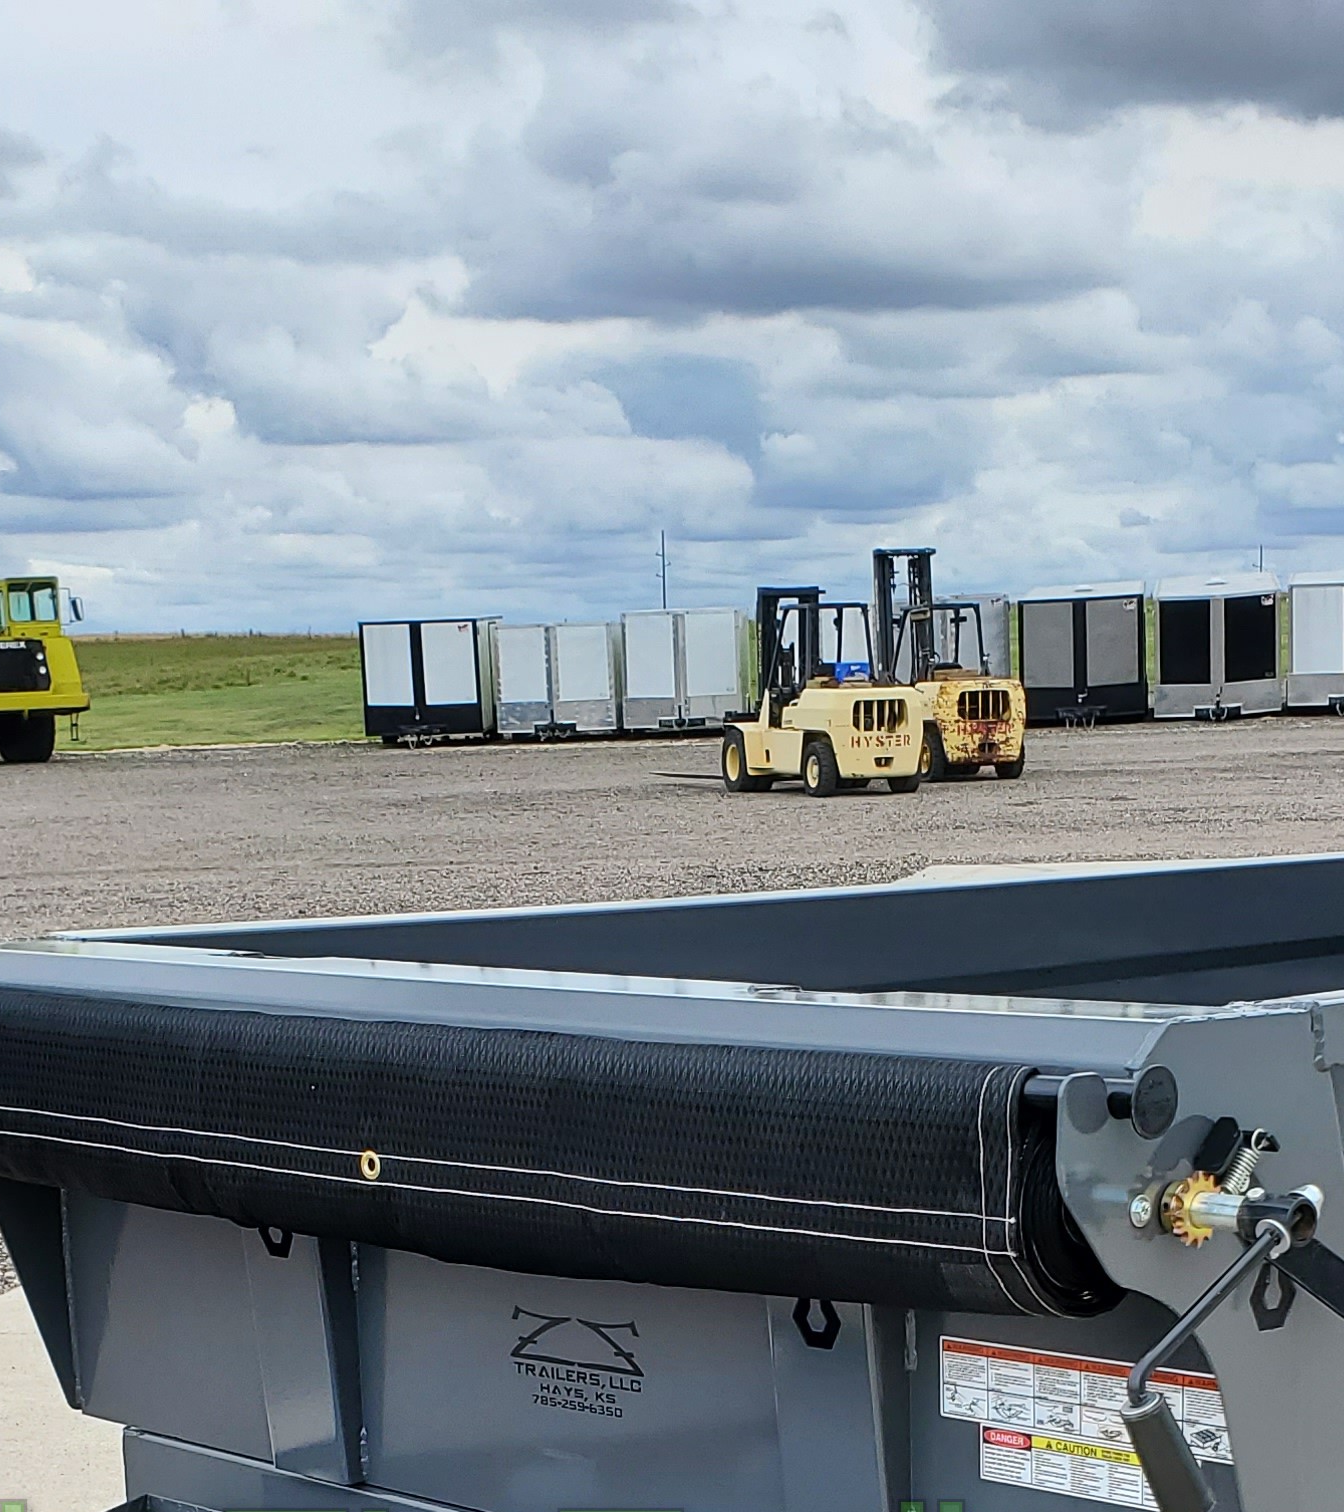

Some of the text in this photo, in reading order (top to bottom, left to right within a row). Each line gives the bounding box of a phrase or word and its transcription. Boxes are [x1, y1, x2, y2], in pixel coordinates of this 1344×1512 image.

[851, 734, 911, 748] HYSTER
[513, 1361, 642, 1393] TRAILERS, LLC
[540, 1382, 616, 1404] HAYS, KS
[990, 1431, 1025, 1447] DANGER
[1055, 1441, 1097, 1458] CAUTION
